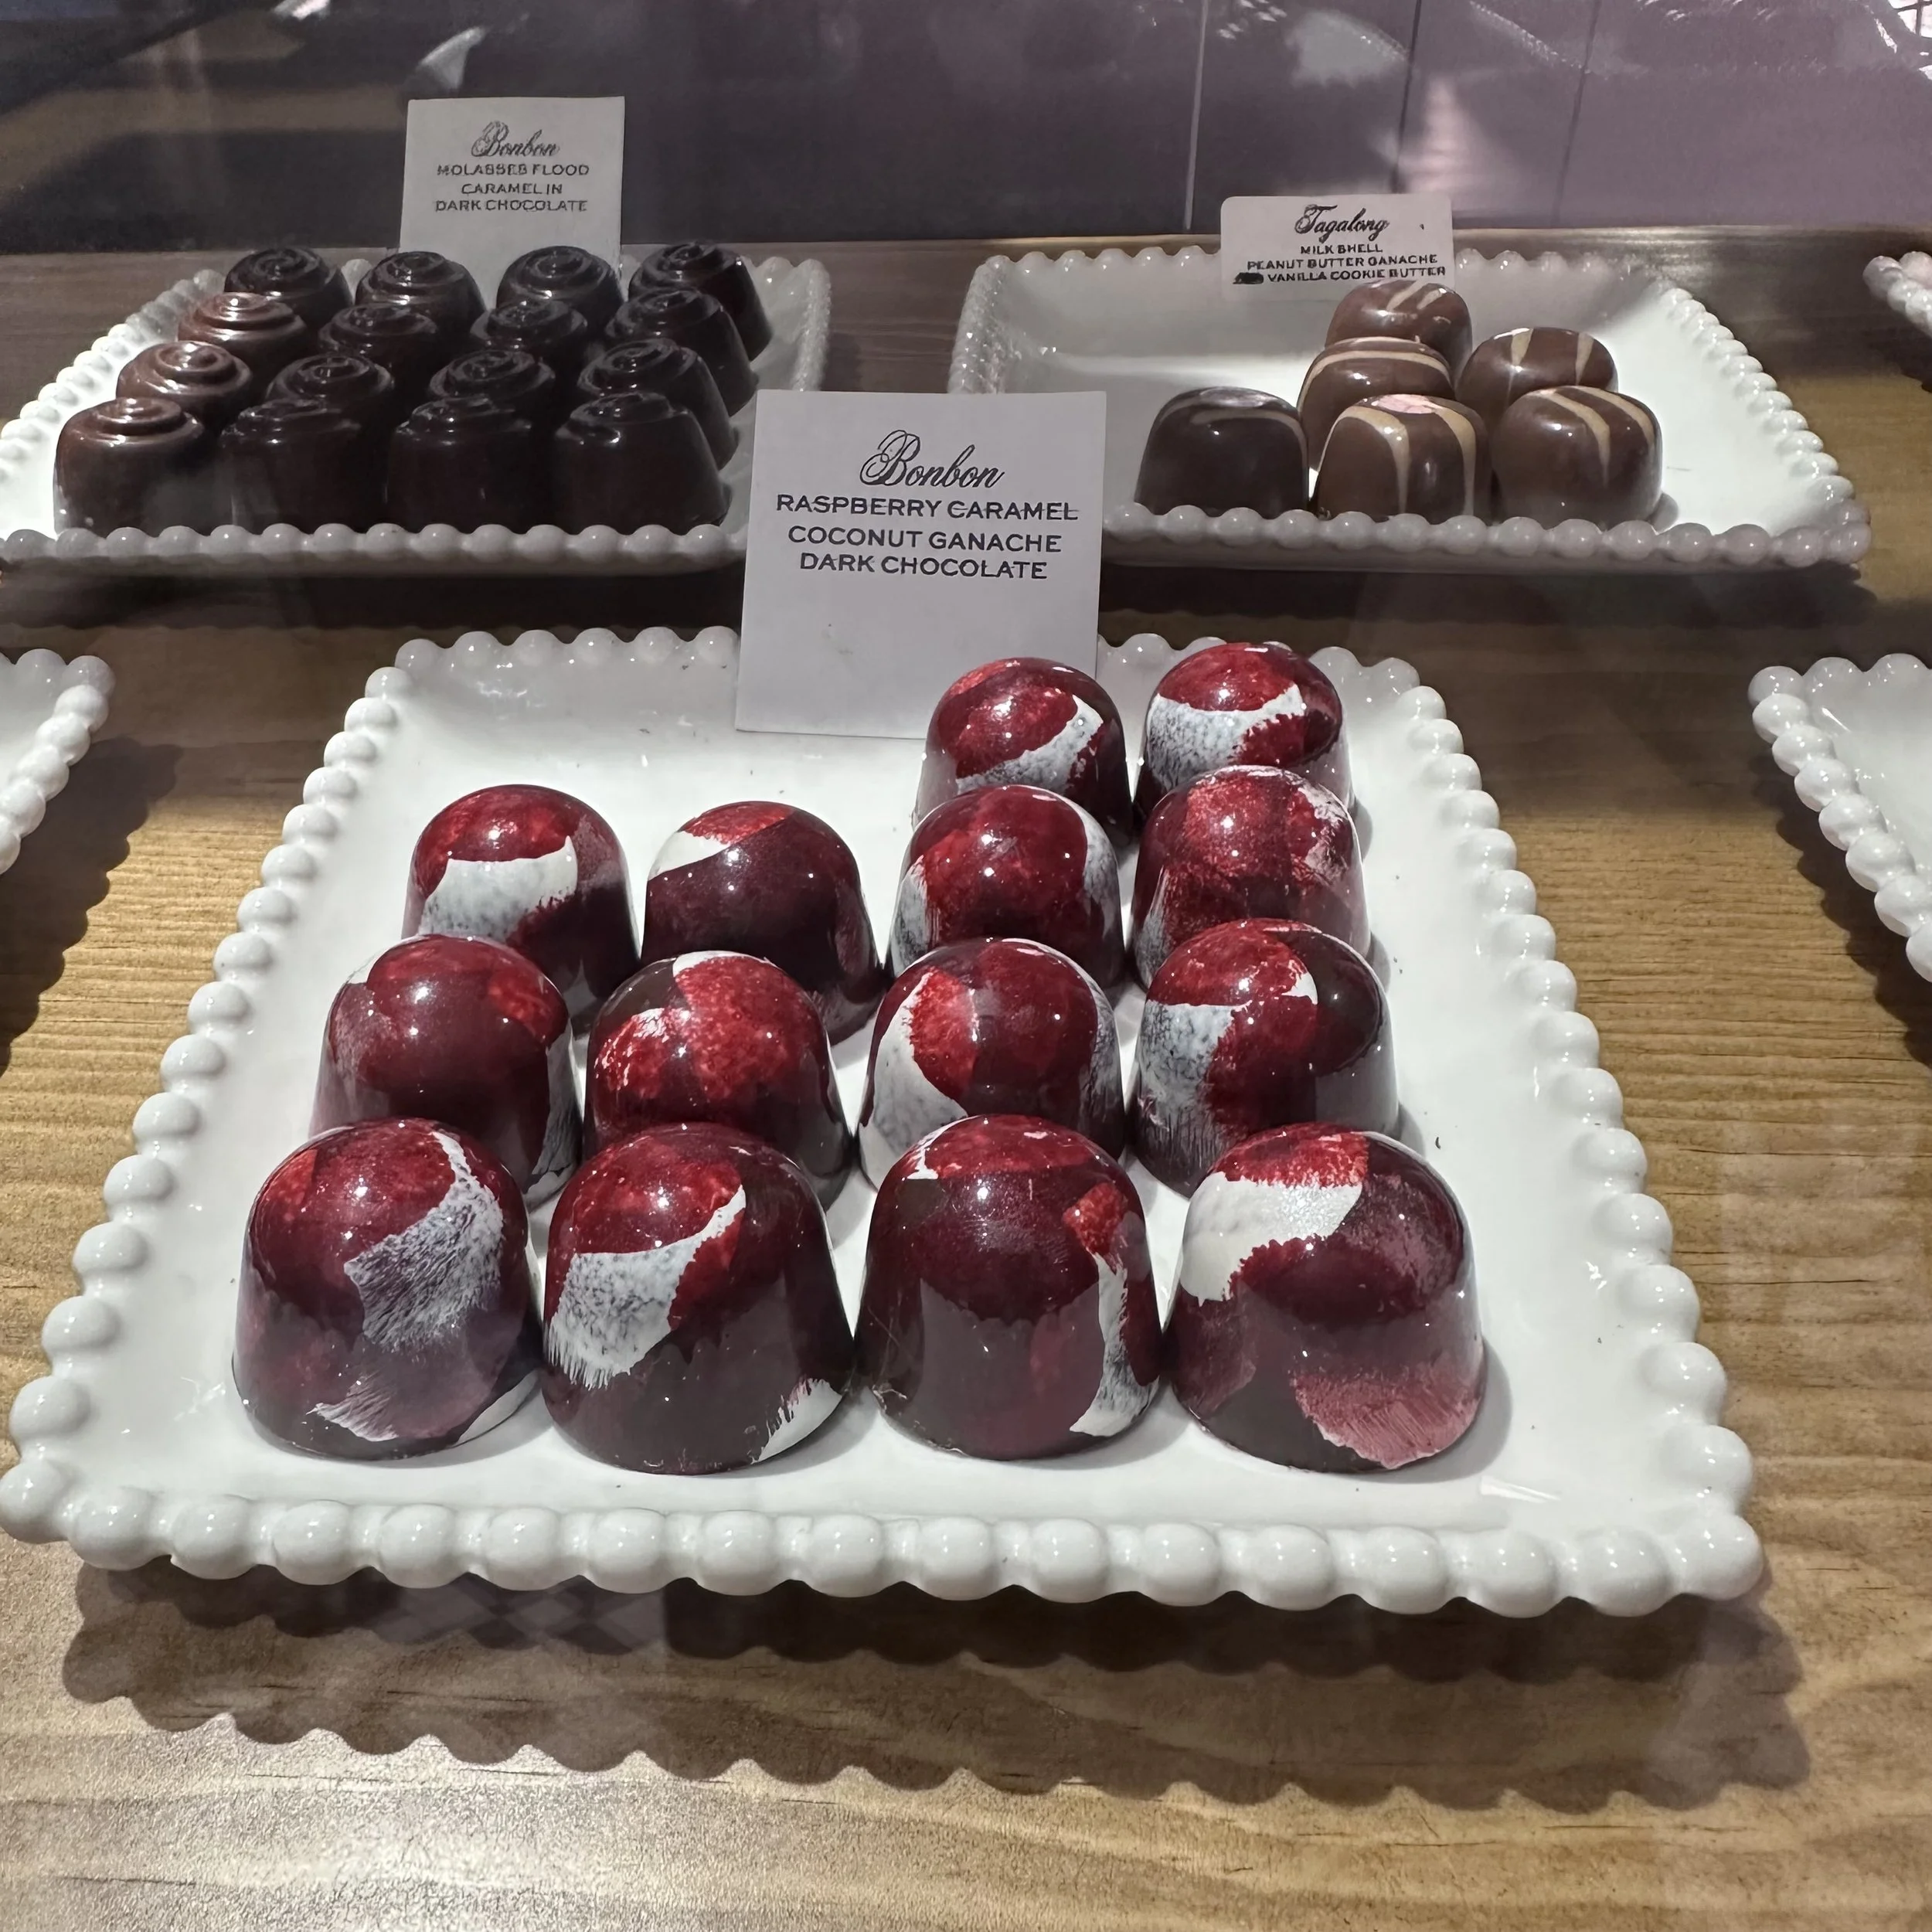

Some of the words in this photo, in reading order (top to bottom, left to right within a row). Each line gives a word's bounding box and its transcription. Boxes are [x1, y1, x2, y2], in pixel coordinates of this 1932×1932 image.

[471, 121, 560, 157] Bonbon
[532, 164, 589, 175] FLOOD
[461, 183, 542, 194] CARAMEL
[546, 184, 563, 195] IN
[436, 200, 481, 212] DARK
[485, 199, 588, 212] CHOCOLATE
[1294, 204, 1389, 243] Tagalong
[1301, 245, 1334, 254] MILK
[1247, 260, 1304, 270] PEANUT
[1308, 257, 1364, 268] BUTTER
[1368, 254, 1437, 266] GANACHE
[1268, 272, 1328, 282] VANILLA
[1330, 270, 1386, 281] COOKIE
[1389, 266, 1446, 277] BUTTER
[859, 430, 1005, 488] Bonbon
[777, 494, 942, 518] RASPBERRY
[947, 500, 1079, 520] CARAMEL
[788, 526, 923, 548] COCONUT
[928, 531, 1062, 553] GANACHE
[800, 552, 875, 573] DARK
[881, 556, 1047, 579] CHOCOLATE
